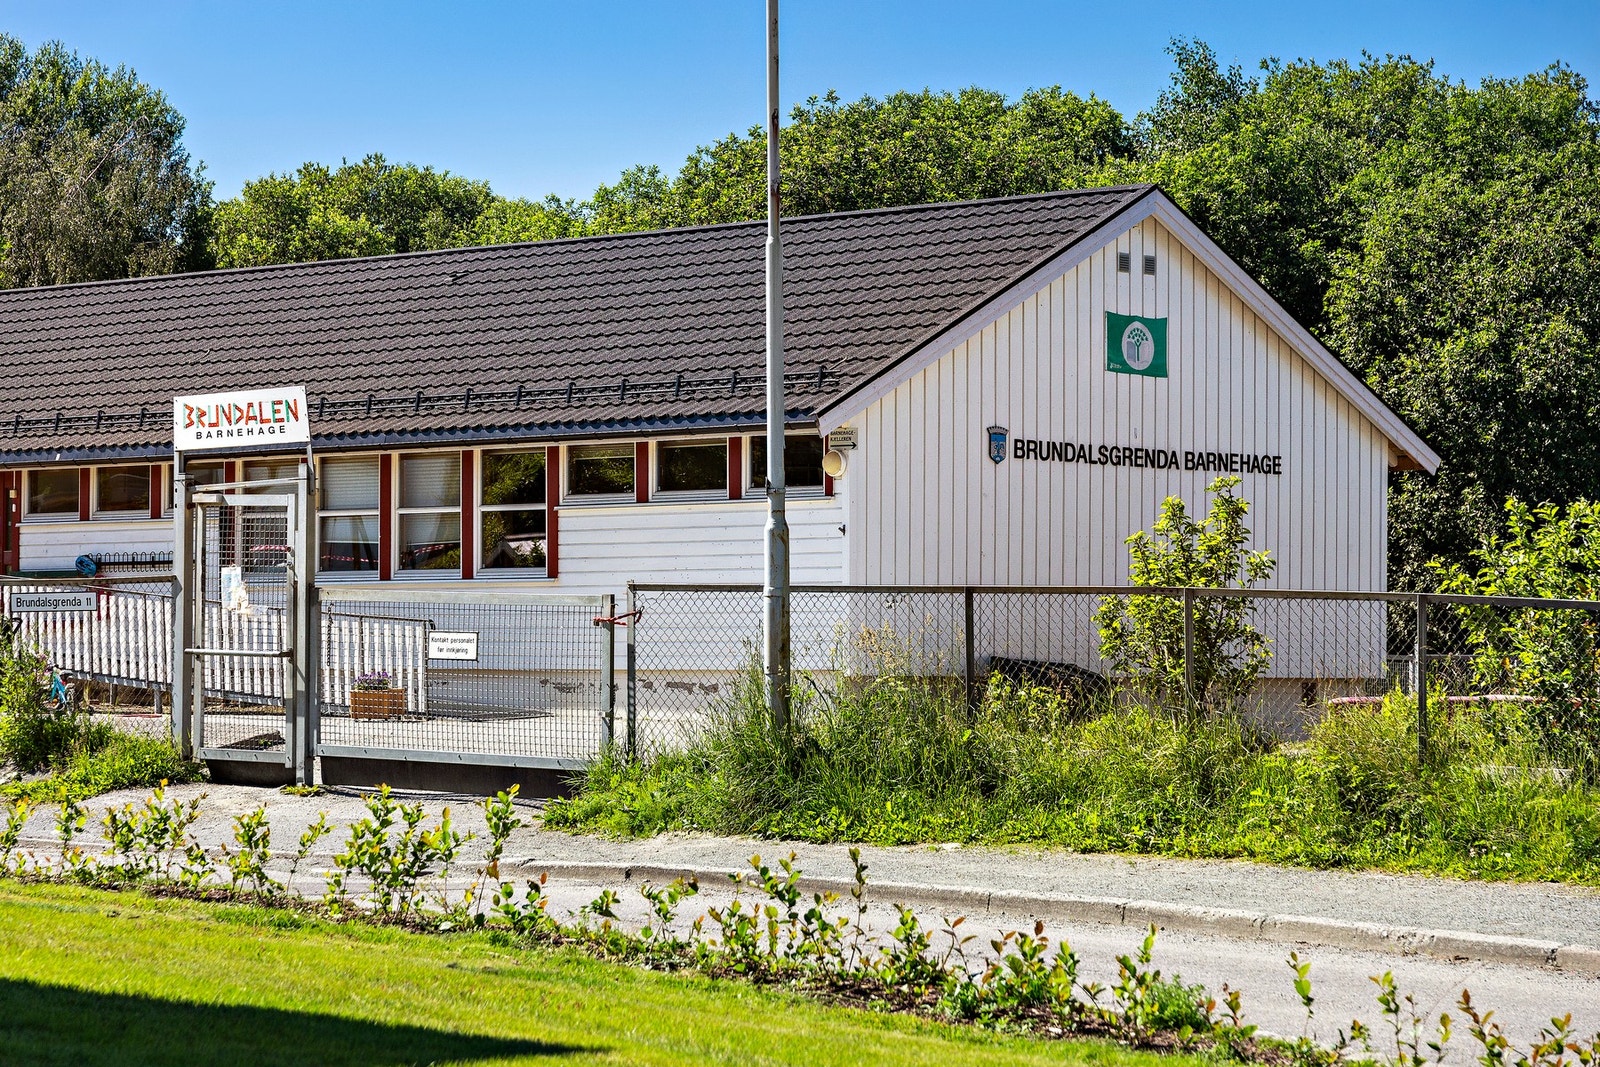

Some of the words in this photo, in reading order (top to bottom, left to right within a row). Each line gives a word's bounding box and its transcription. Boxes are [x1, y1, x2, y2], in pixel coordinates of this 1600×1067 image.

[183, 399, 299, 429] BRUNDALEN
[196, 425, 286, 440] BARNEHAGE
[1013, 438, 1179, 470] BRUNDALSGRENDA
[1184, 451, 1283, 475] BARNEHAGE
[16, 596, 82, 609] Brundalsgrenda
[86, 597, 92, 607] 11
[446, 647, 469, 655] innkjøring
